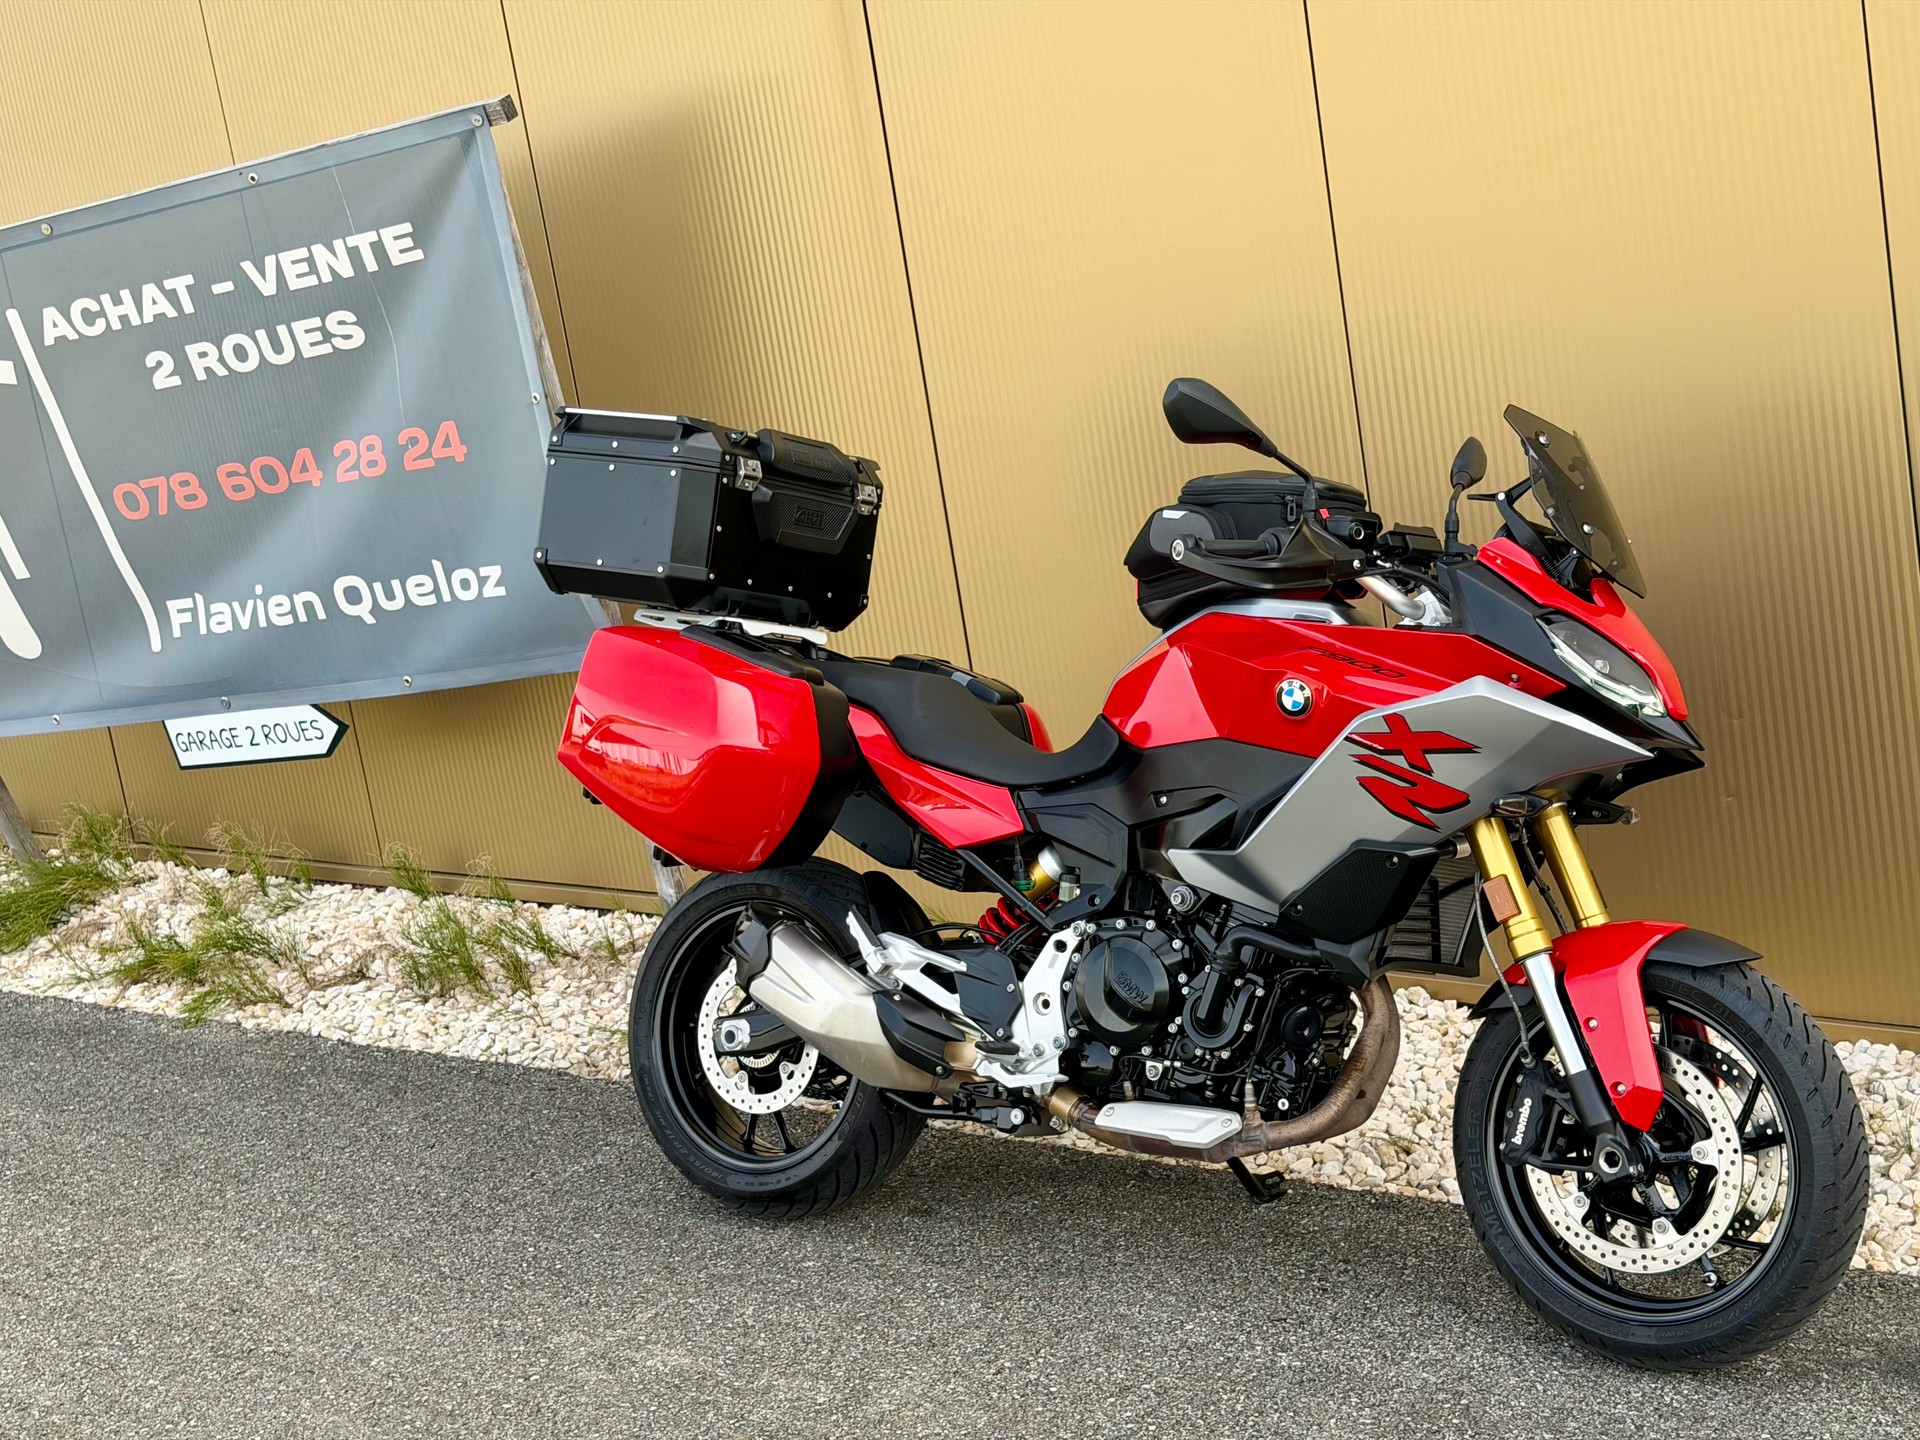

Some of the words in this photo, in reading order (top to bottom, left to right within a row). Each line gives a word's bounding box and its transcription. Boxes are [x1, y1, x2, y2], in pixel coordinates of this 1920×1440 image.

[42, 273, 195, 347] ACHAT
[210, 280, 235, 295] -
[239, 222, 425, 298] VENTE
[145, 350, 182, 391] 2
[184, 310, 367, 382] ROUES
[113, 472, 208, 521] 078
[216, 448, 324, 501] 604
[332, 434, 387, 483] 28
[398, 420, 468, 472] 24
[165, 584, 327, 639] Flavien
[333, 558, 507, 625] Queloz
[175, 727, 243, 752] GARAGE
[245, 725, 260, 747] 2
[261, 719, 325, 746] ROUES
[1116, 970, 1149, 1004] BMW
[1510, 1097, 1533, 1146] brembo
[1467, 1109, 1503, 1236] METZELER
